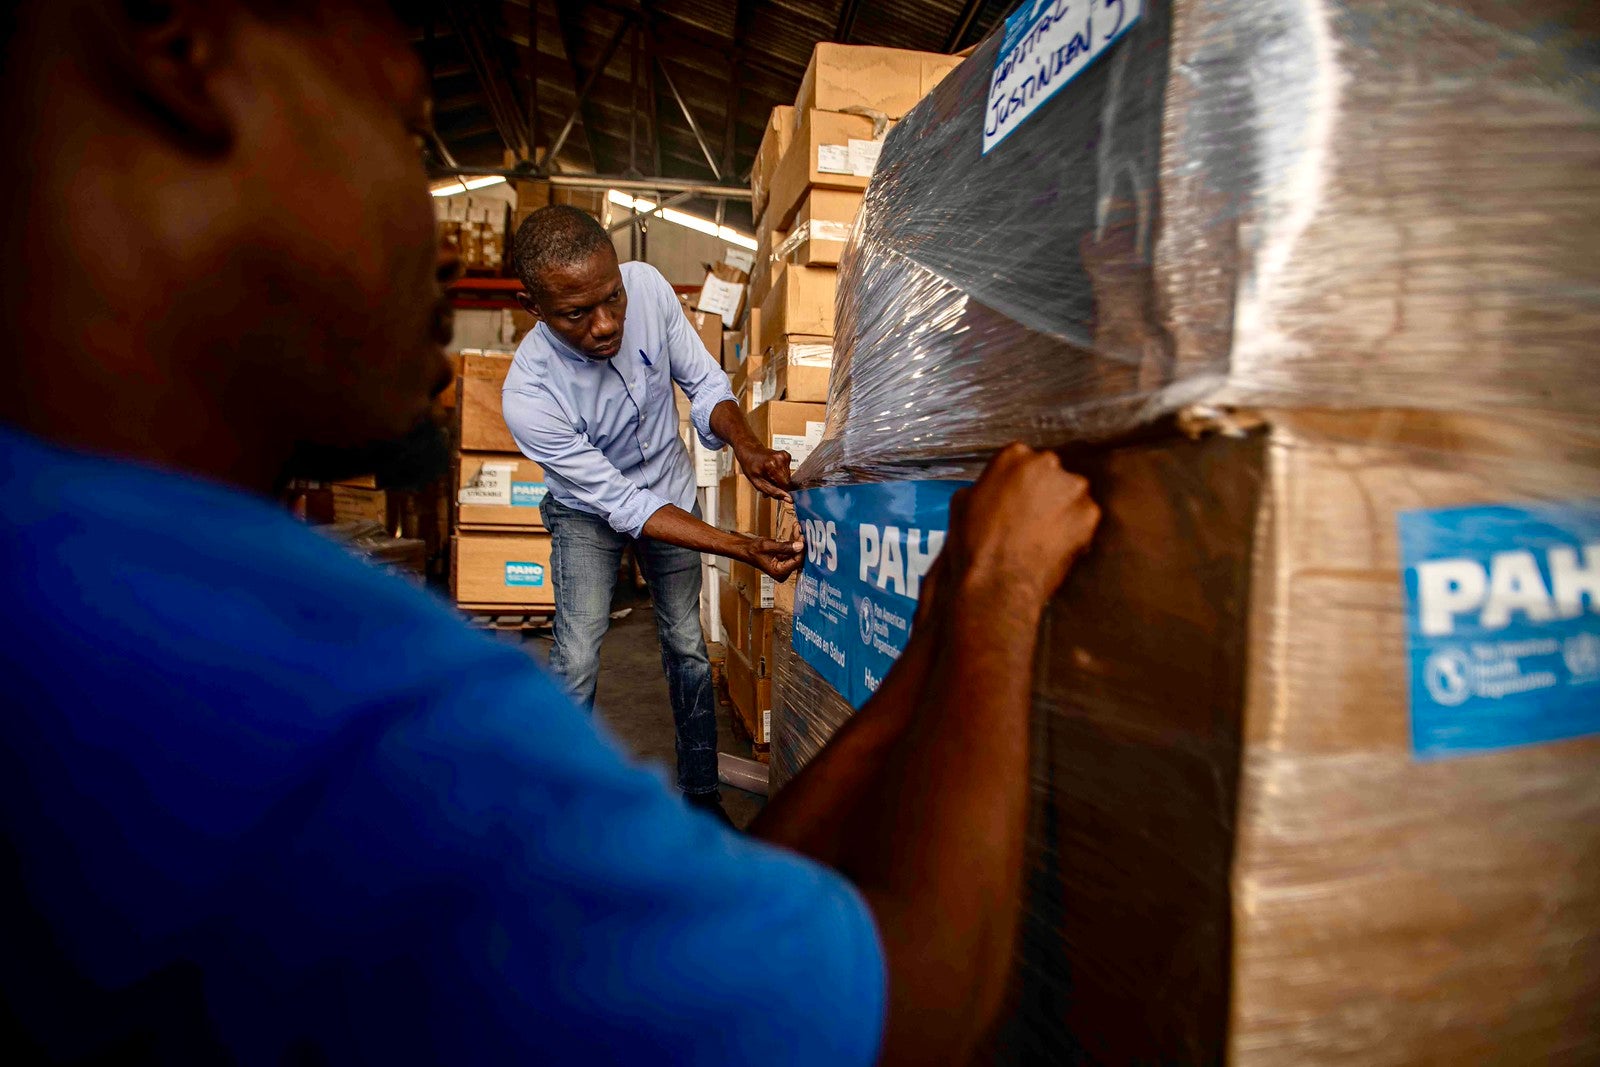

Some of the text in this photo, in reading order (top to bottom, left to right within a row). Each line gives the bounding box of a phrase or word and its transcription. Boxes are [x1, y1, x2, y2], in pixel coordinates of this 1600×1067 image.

[506, 564, 543, 575] PAHO
[804, 518, 838, 572] OPS
[1418, 542, 1600, 635] PAH
